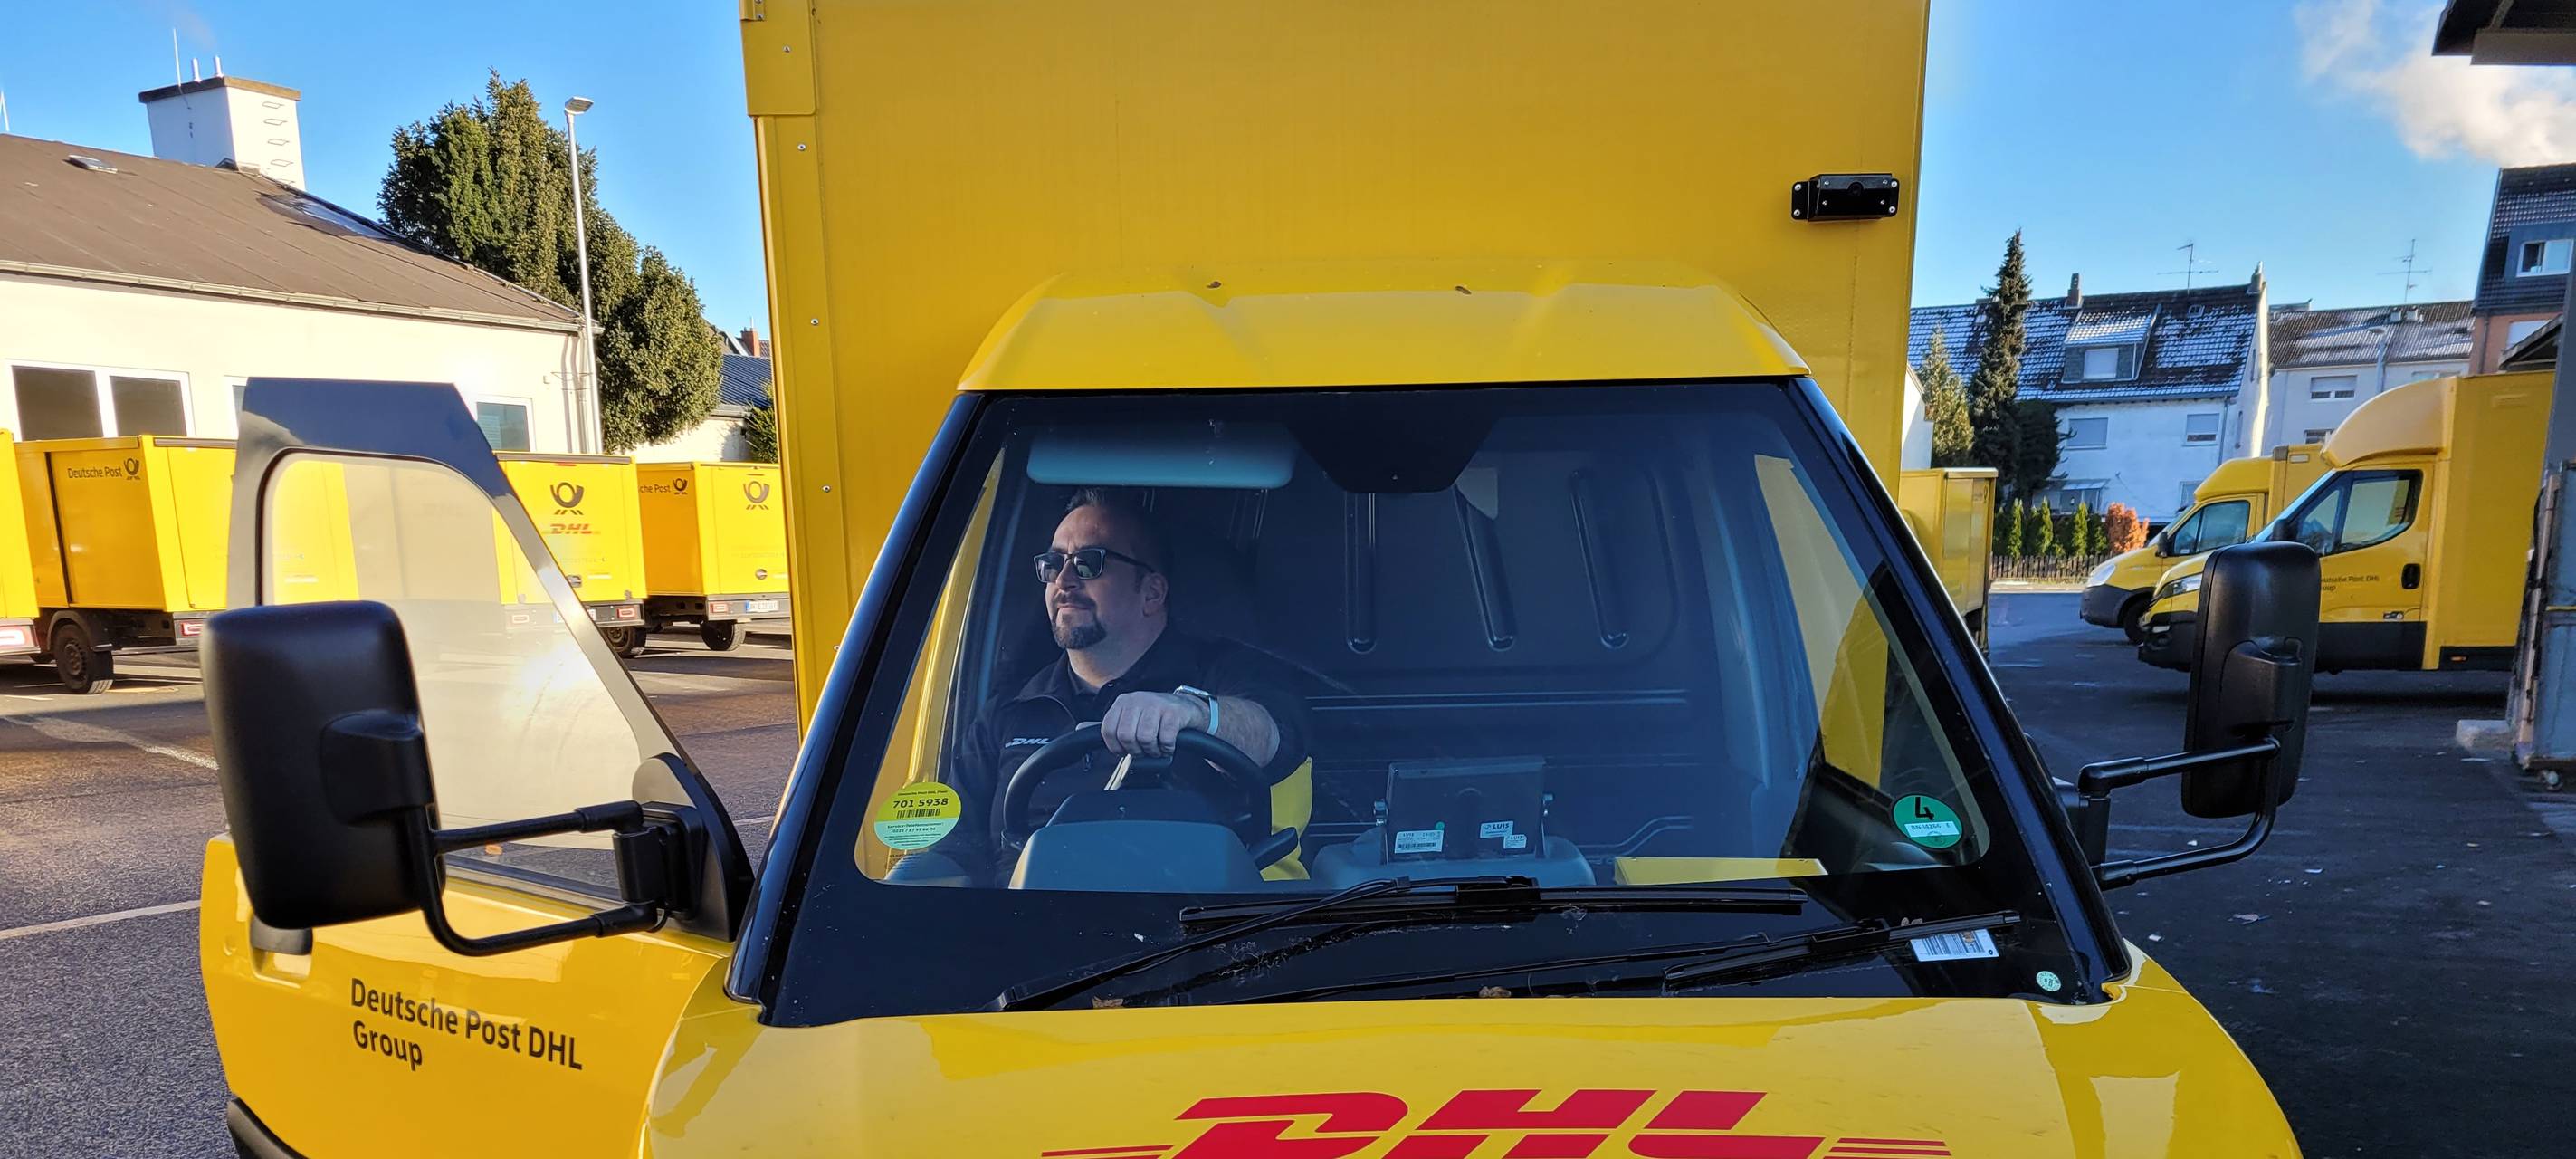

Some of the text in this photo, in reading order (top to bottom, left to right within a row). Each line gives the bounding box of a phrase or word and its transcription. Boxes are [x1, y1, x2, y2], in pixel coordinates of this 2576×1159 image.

[67, 466, 123, 479] Deutsche Post
[654, 484, 671, 493] Post
[549, 523, 594, 534] DHL
[1011, 737, 1051, 746] DHL
[892, 798, 949, 809] 701 5938
[1914, 796, 1934, 821] 4
[350, 977, 584, 1071] Deutsche Post DHL
[353, 1020, 424, 1072] Group
[1168, 1089, 1826, 1159] DHL
